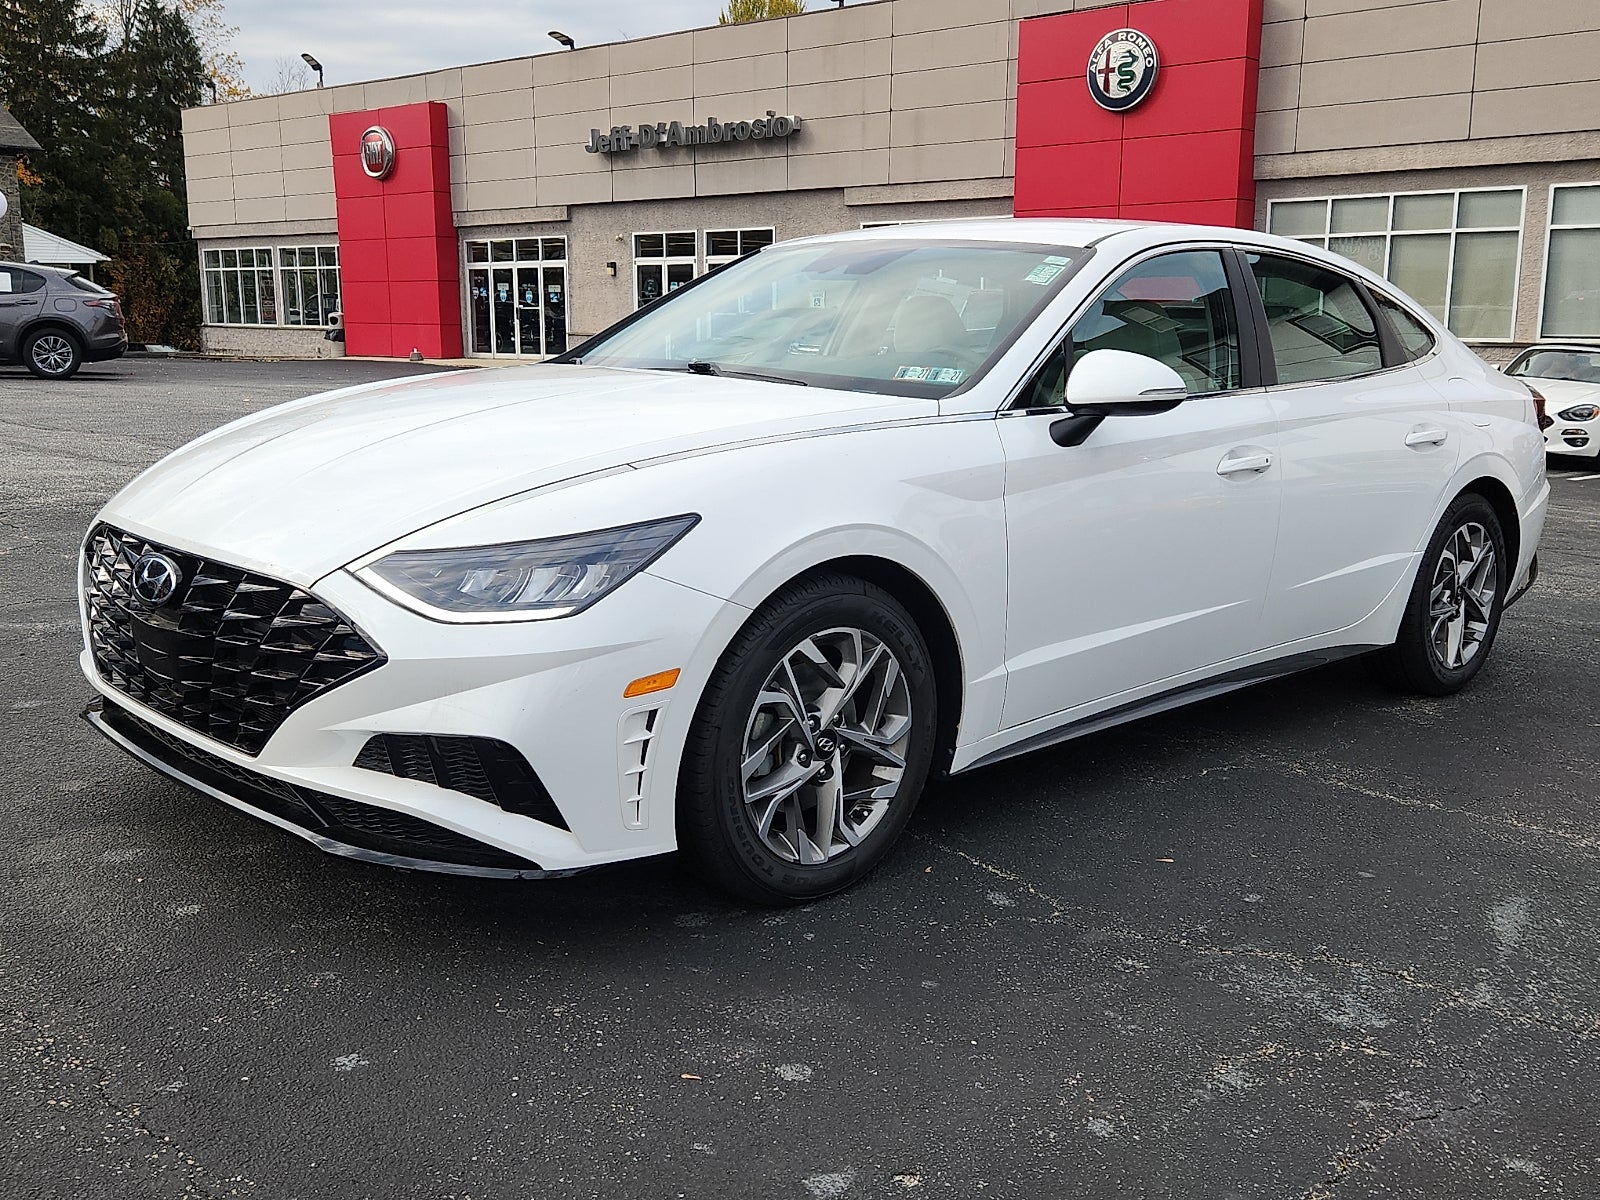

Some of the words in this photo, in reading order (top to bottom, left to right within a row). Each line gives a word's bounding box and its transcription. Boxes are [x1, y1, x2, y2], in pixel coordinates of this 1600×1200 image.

[1089, 38, 1112, 73] ALFA
[1117, 32, 1154, 68] ROMEO
[585, 125, 632, 154] Jeff
[638, 110, 794, 150] D'Ambrosio
[871, 610, 924, 674] KELLY
